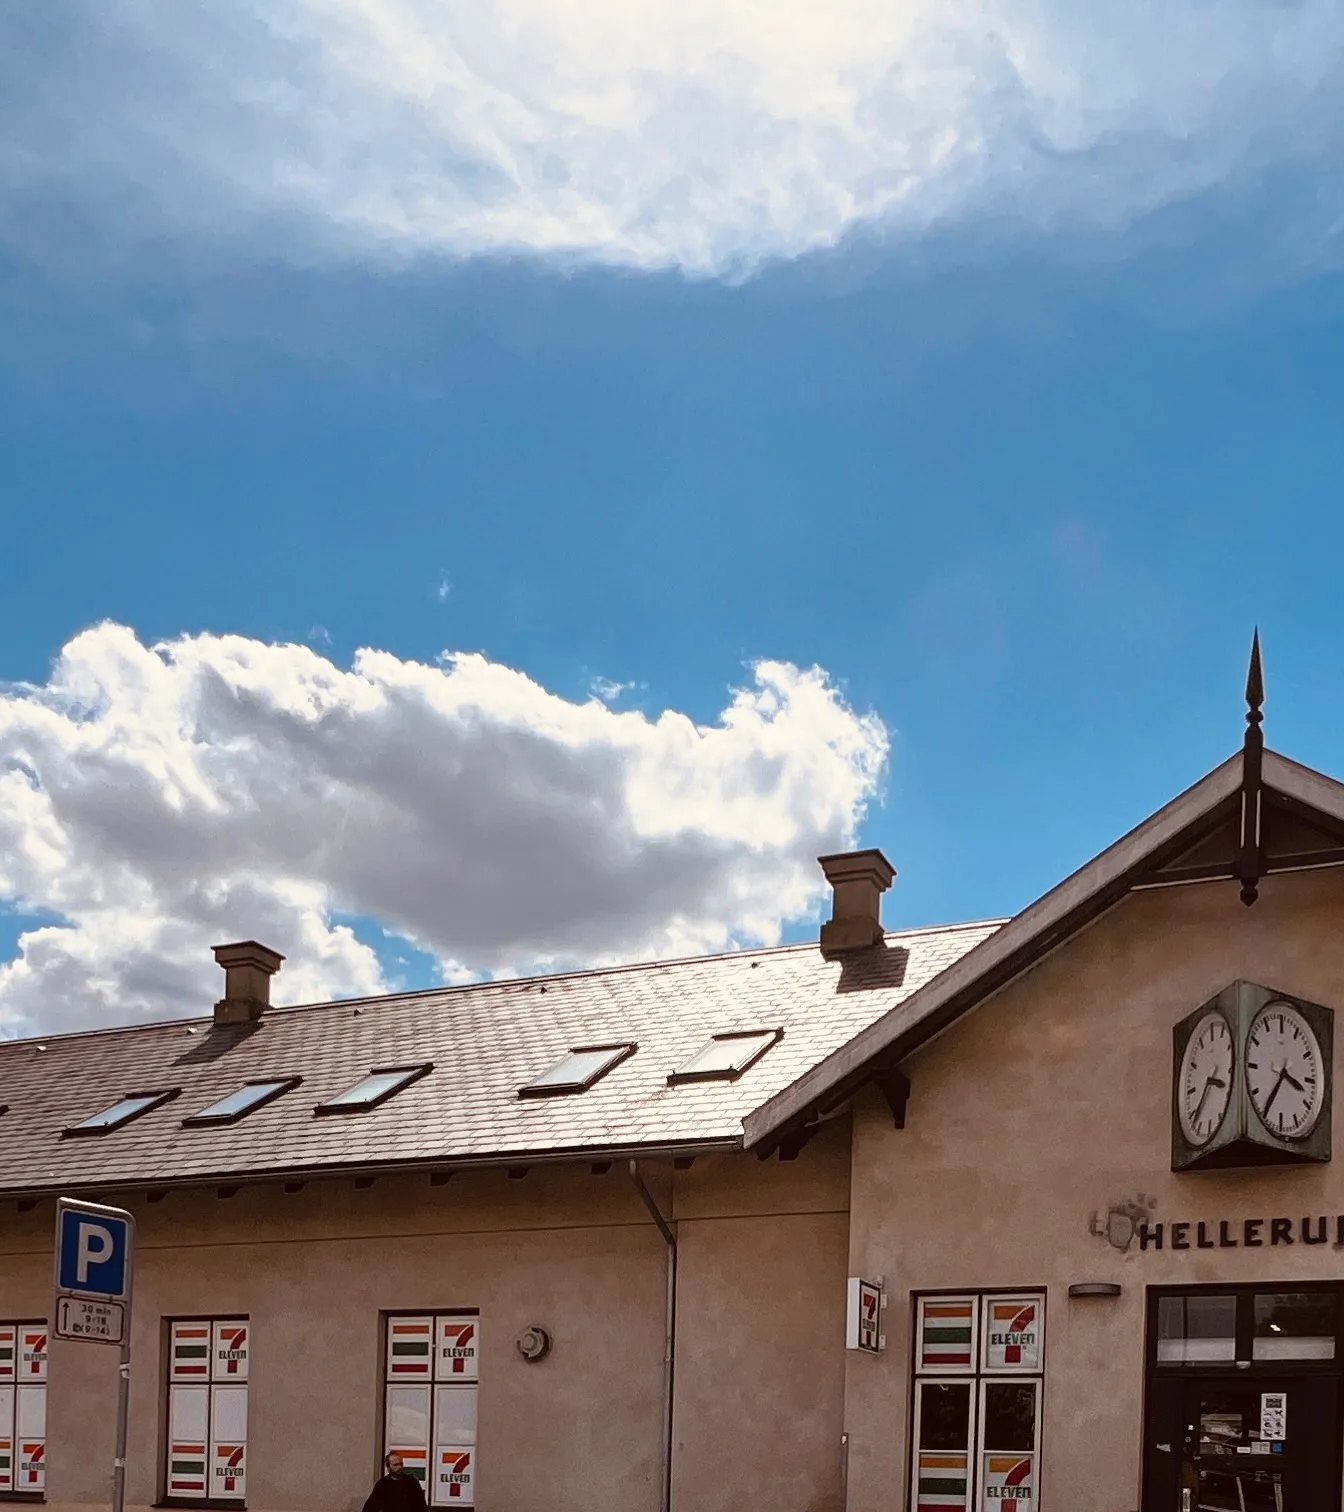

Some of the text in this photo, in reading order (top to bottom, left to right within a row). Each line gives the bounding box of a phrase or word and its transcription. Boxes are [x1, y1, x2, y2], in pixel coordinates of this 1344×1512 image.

[76, 1221, 114, 1283] P
[220, 1328, 247, 1373] 7
[445, 1324, 474, 1372] 7
[993, 1304, 1035, 1363] 7
[217, 1446, 244, 1490] 7
[442, 1453, 470, 1496] 7
